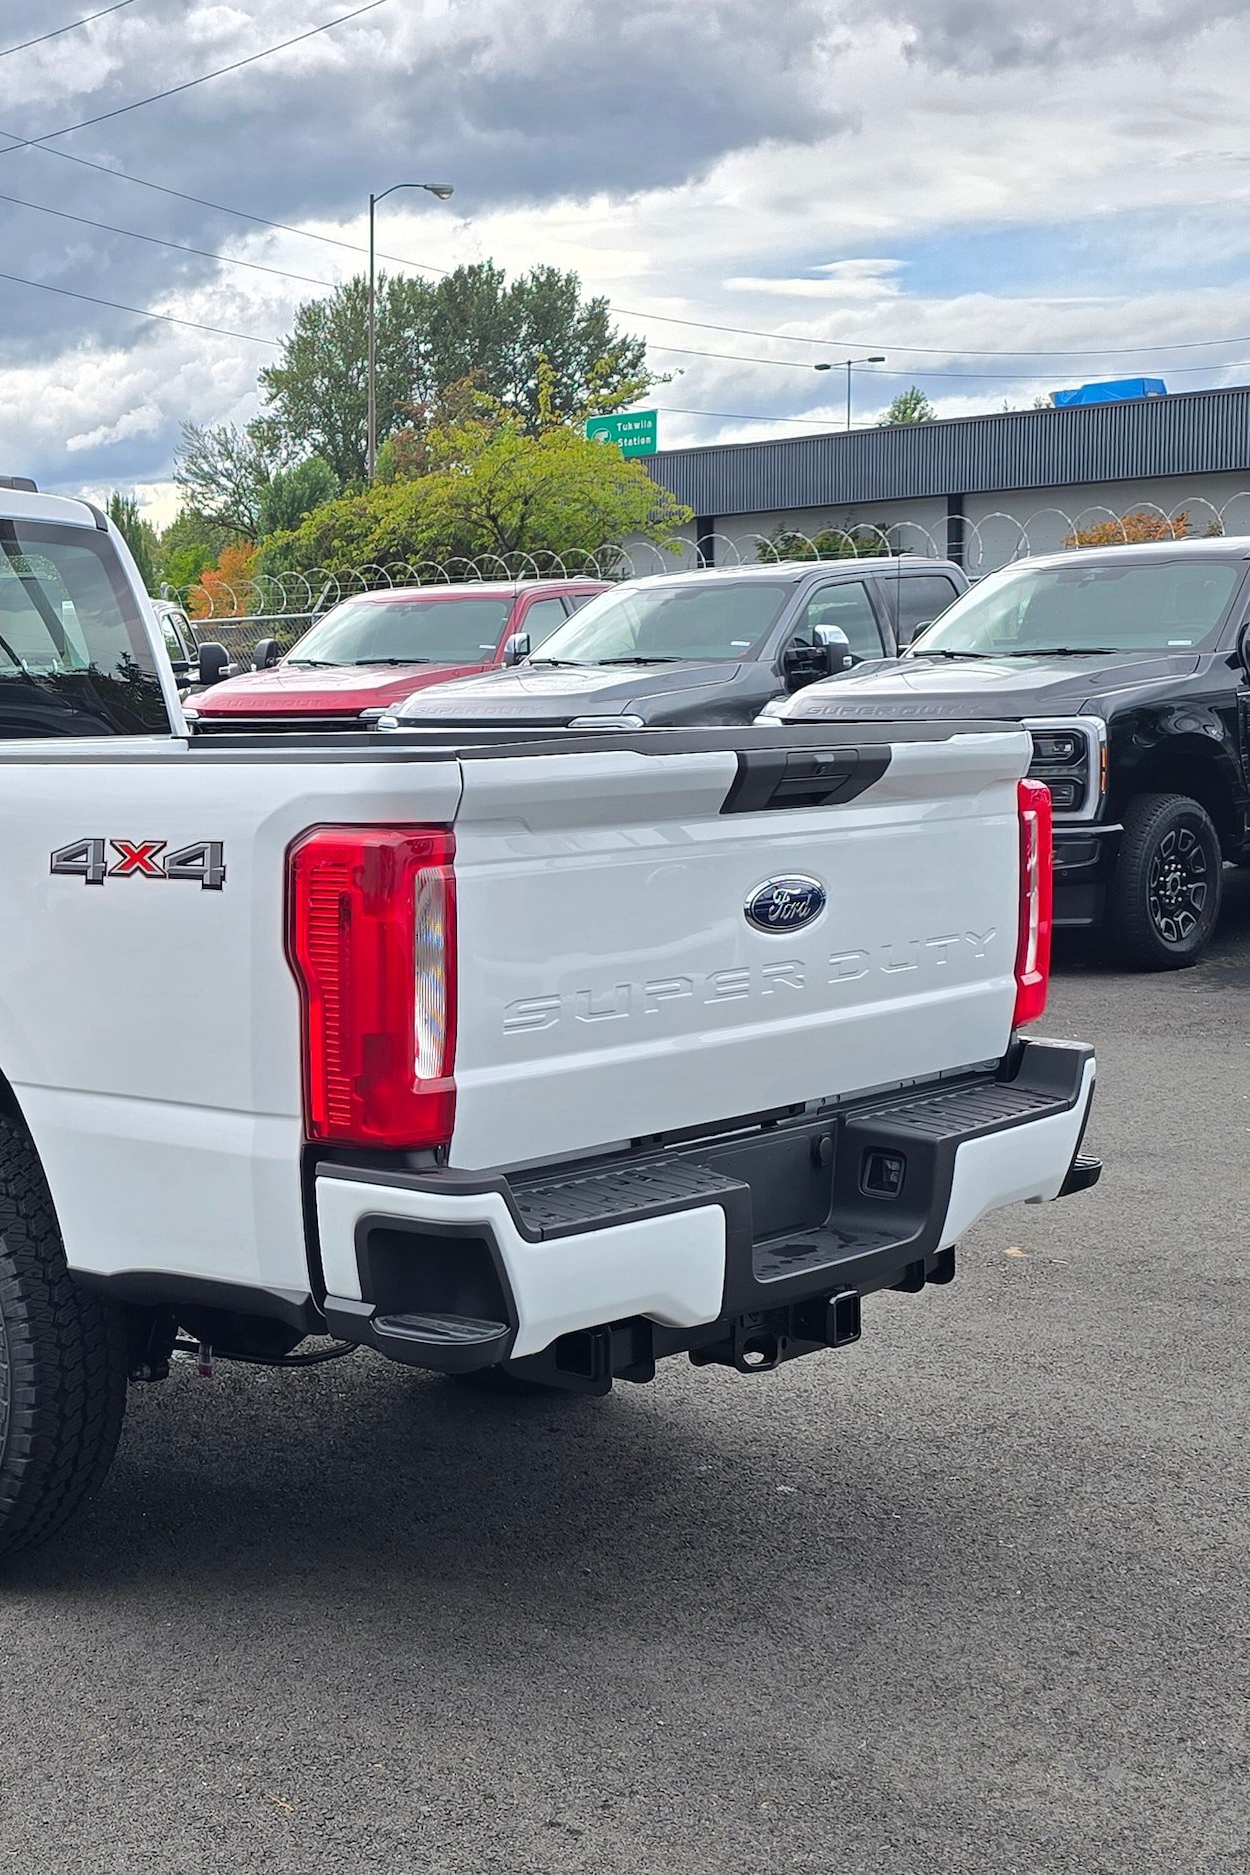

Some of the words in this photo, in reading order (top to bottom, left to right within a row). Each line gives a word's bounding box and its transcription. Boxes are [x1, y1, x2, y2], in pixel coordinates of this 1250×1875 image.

[616, 420, 653, 432] Tukwila
[617, 436, 652, 448] Station
[805, 705, 896, 716] SUPER
[900, 703, 982, 716] DUTY
[768, 887, 813, 921] Ford
[502, 959, 805, 1035] SUPER
[827, 927, 997, 984] DUTY
